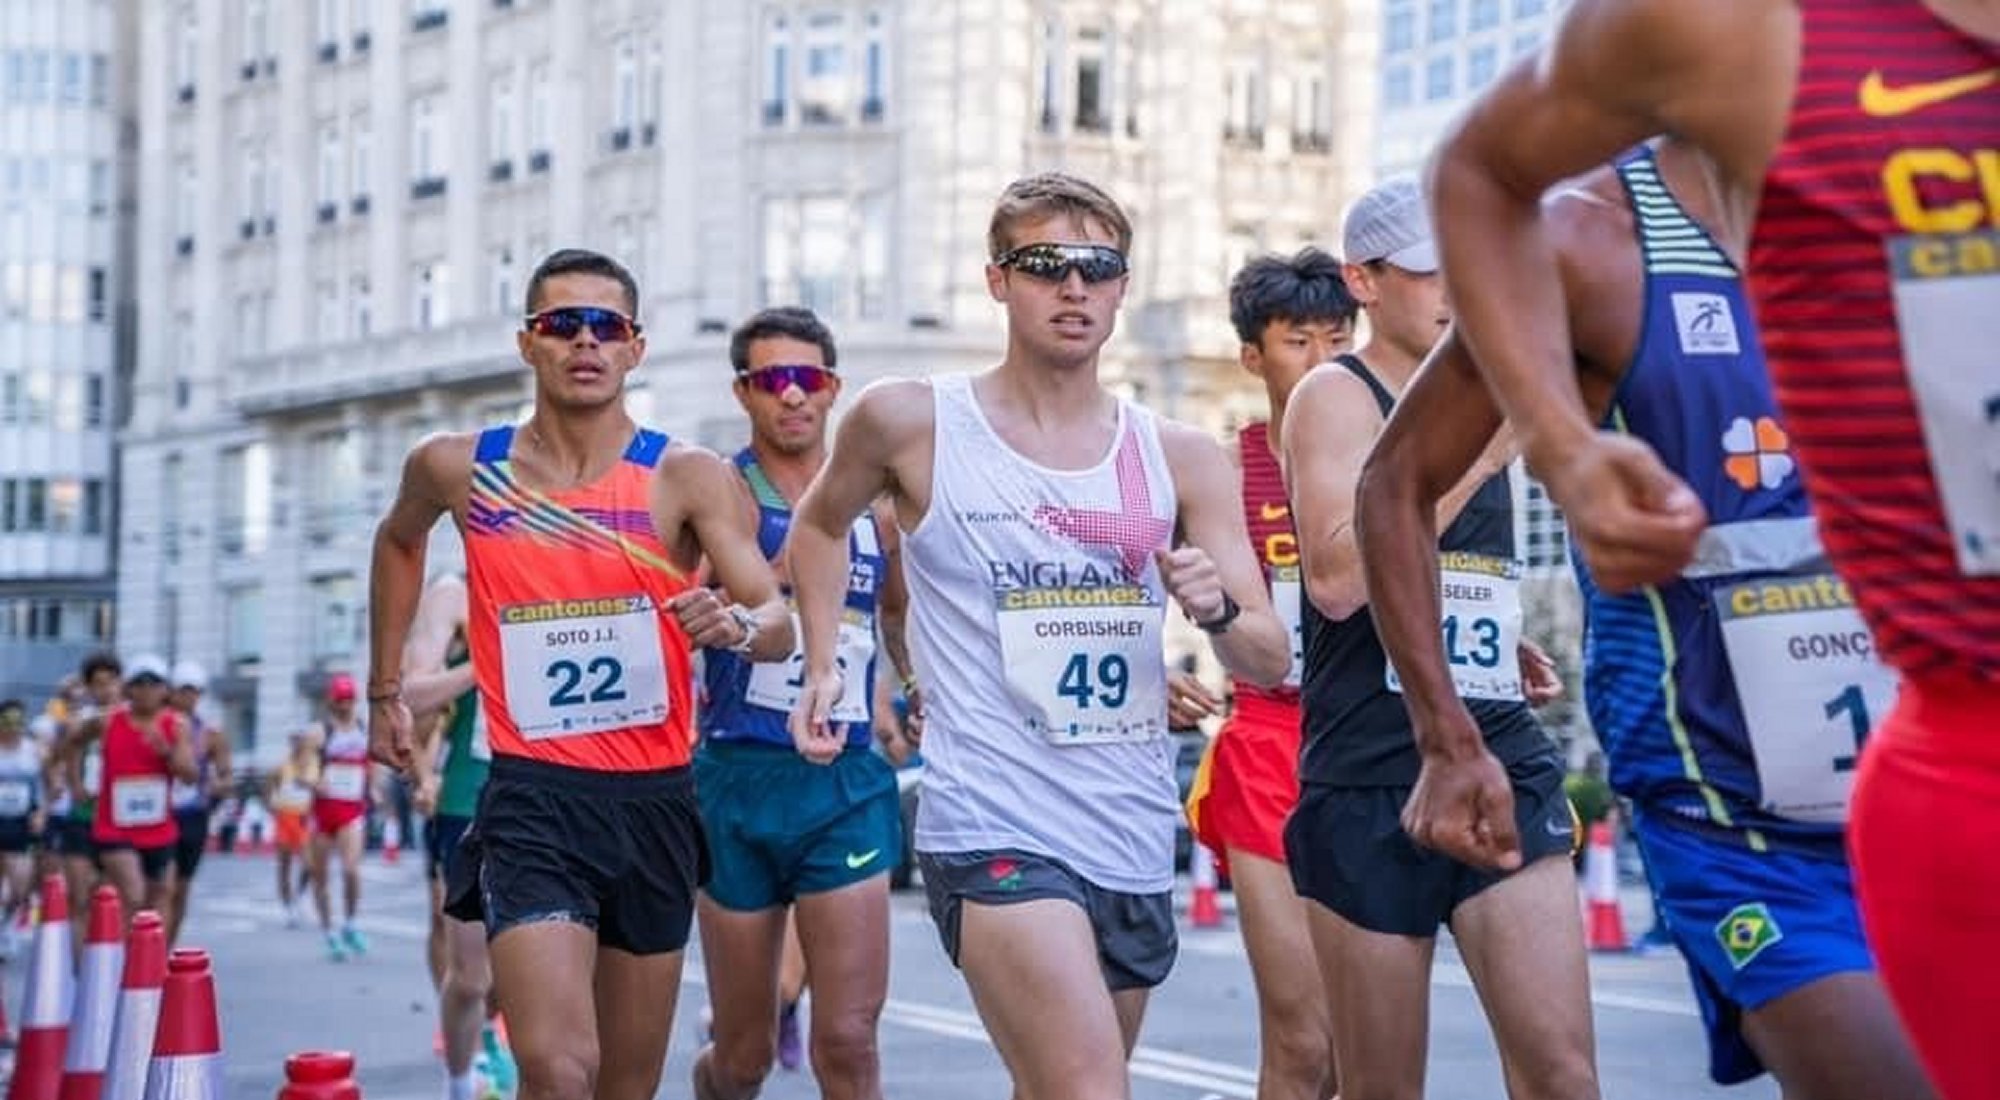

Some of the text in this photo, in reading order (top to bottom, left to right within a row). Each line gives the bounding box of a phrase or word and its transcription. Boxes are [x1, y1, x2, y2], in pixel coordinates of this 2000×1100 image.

[545, 628, 590, 646] SOTO
[1034, 620, 1144, 638] CORBISHLEY
[1442, 615, 1500, 668] 13
[546, 655, 627, 707] 22
[1056, 653, 1129, 709] 49
